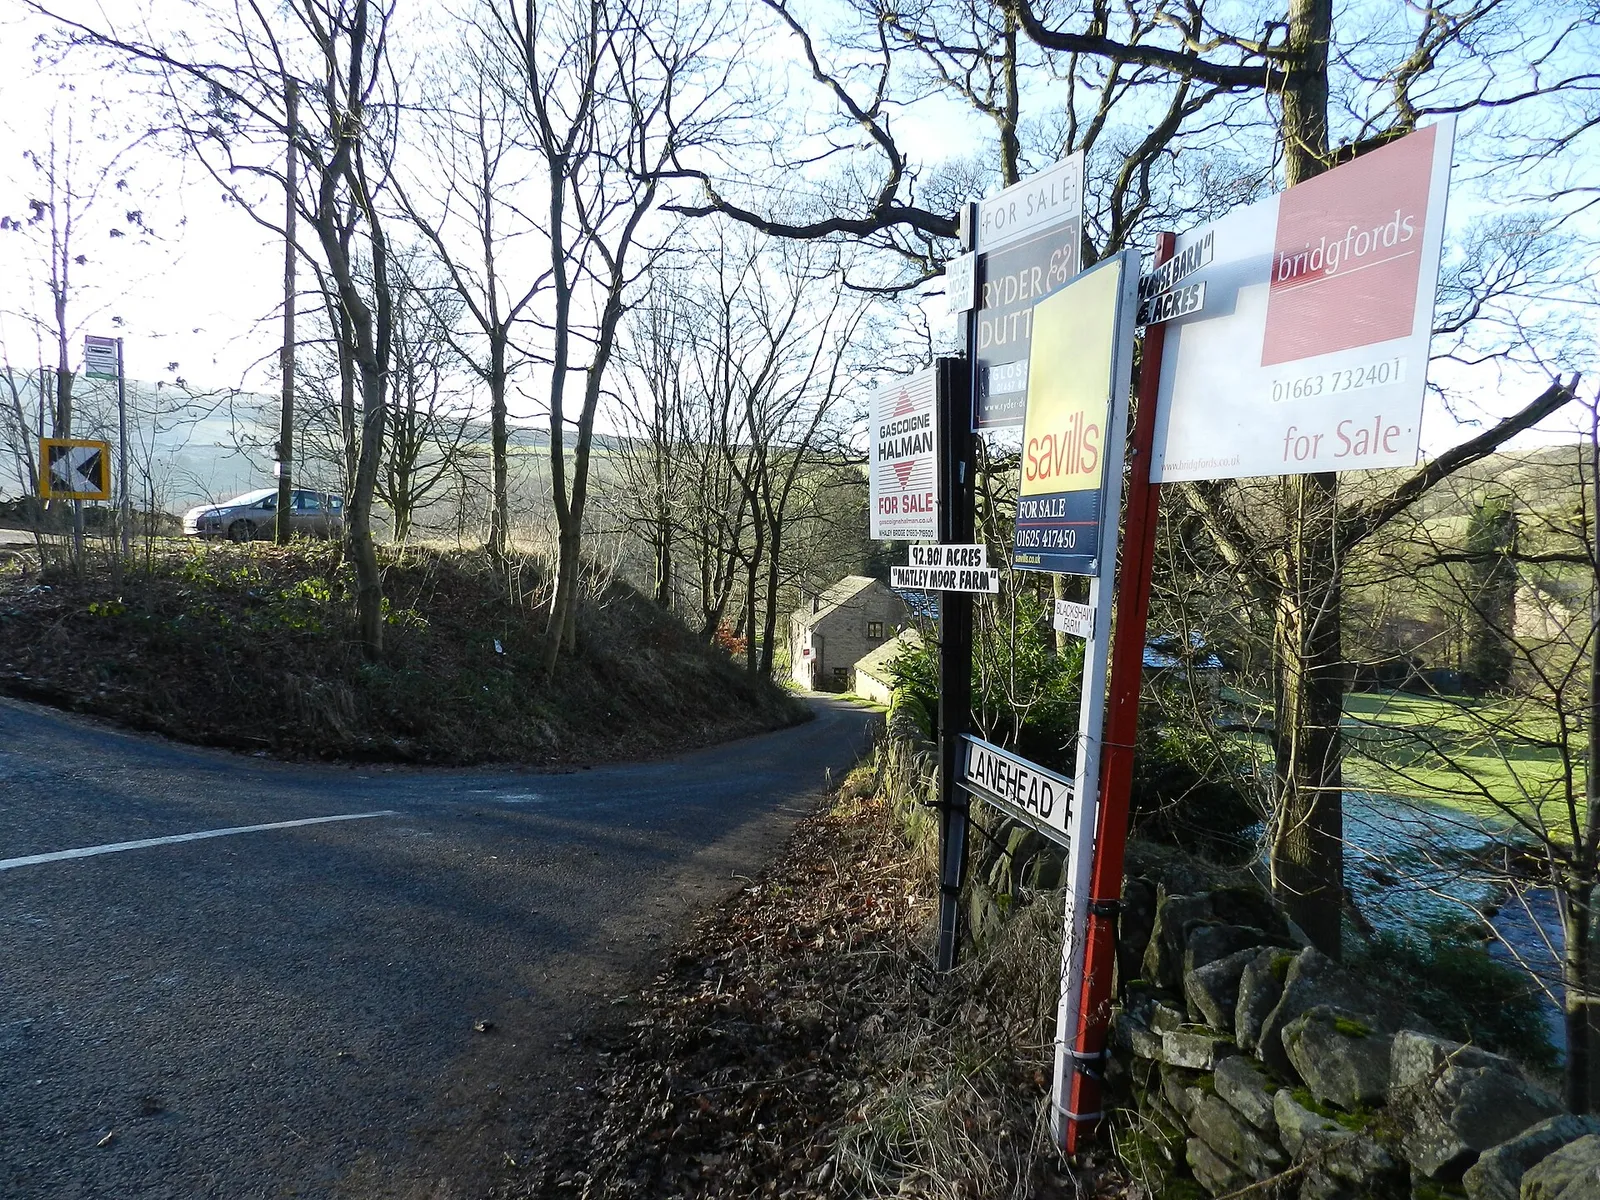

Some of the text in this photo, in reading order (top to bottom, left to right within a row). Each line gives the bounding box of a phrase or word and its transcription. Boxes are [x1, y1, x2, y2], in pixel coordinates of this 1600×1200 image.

[984, 176, 1071, 235] FOR SALE
[1277, 208, 1414, 282] bridgfords
[981, 266, 1042, 310] RYDER
[1152, 284, 1200, 322] ACRES
[1272, 359, 1400, 402] 01663 732401
[879, 413, 930, 439] GASCOIGNE
[1282, 415, 1401, 462] for Sale
[878, 431, 933, 461] HALMAN
[1026, 410, 1099, 482] savills
[878, 492, 933, 515] FOR SALE
[1018, 498, 1066, 519] FOR SALE
[1016, 529, 1076, 549] 01625 417450
[945, 548, 982, 567] ACRES
[929, 570, 957, 589] MOOR
[1063, 617, 1081, 634] FARM
[967, 745, 1054, 819] LANEHEAD
